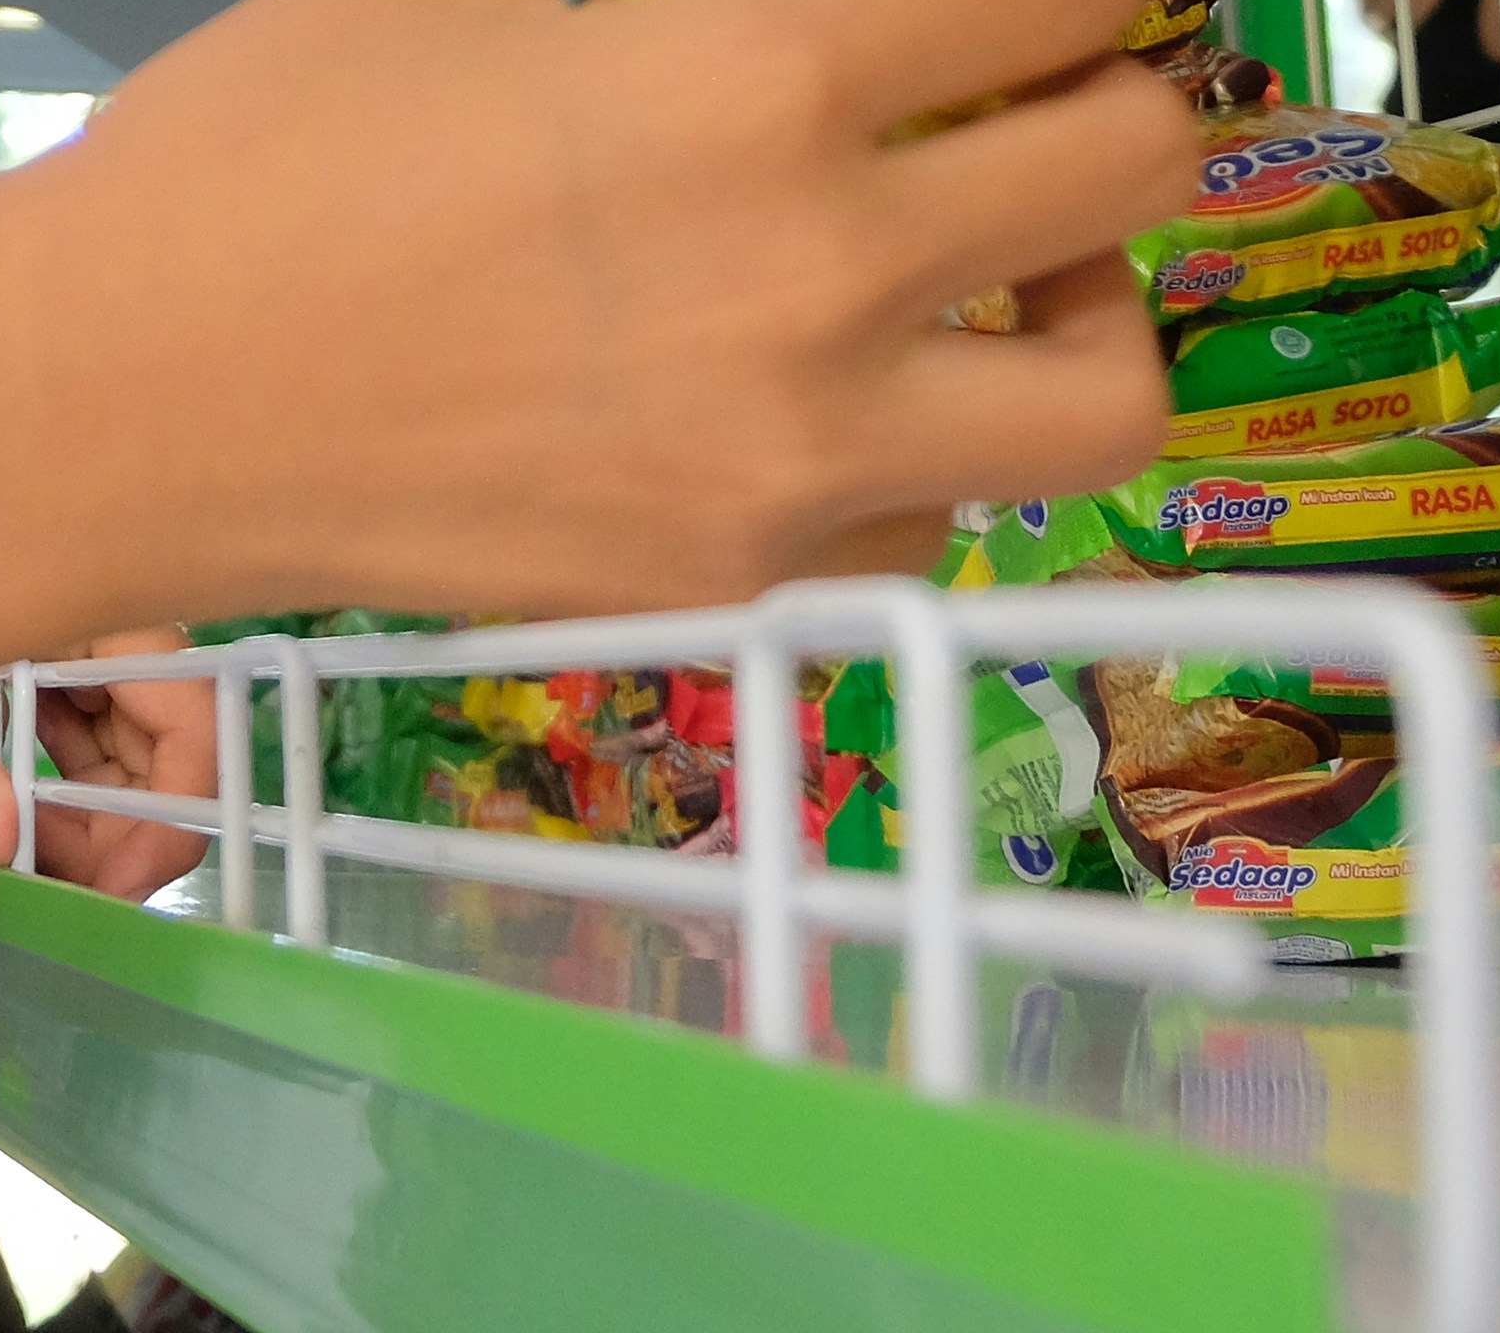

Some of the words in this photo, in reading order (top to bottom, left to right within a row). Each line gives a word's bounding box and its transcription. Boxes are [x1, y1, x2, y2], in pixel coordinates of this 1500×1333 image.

[1293, 156, 1393, 184] Mie
[1323, 237, 1386, 269] RASA
[1400, 225, 1460, 258] SOTO
[1246, 407, 1318, 444] RASA
[1333, 391, 1412, 426] SOTO
[1167, 486, 1199, 500] Mie
[1300, 490, 1319, 505] Mi
[1410, 484, 1498, 518] RASA
[1158, 495, 1291, 530] Sedaap
[1182, 845, 1216, 863] Mie
[1167, 857, 1318, 895] Sedaap
[1330, 862, 1351, 879] Mi
[1232, 888, 1285, 903] Instant
